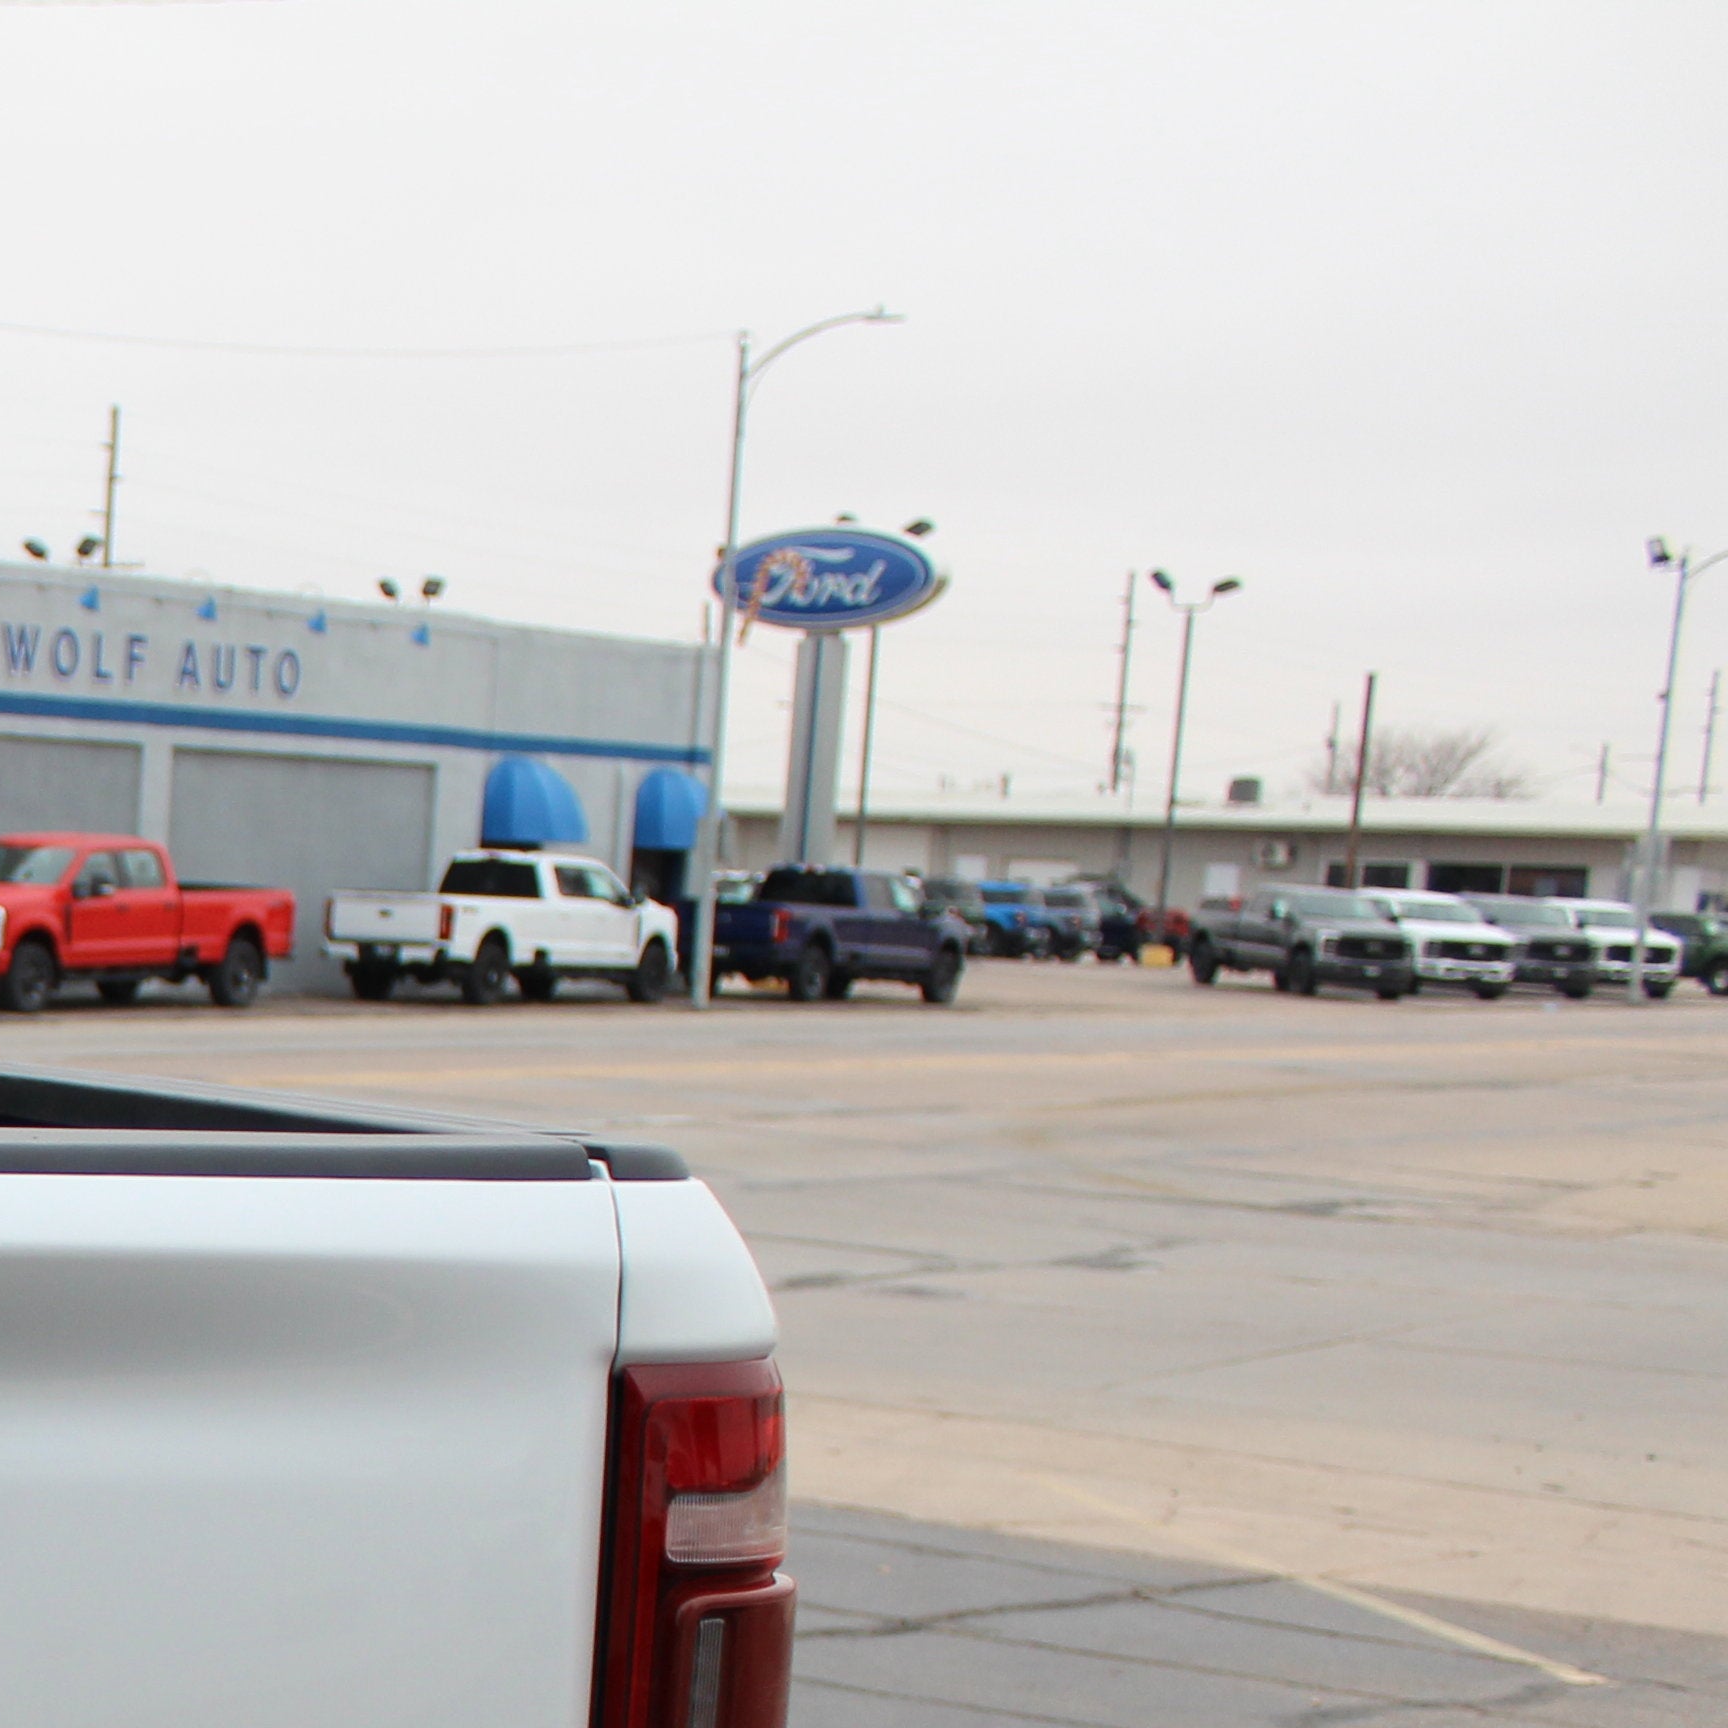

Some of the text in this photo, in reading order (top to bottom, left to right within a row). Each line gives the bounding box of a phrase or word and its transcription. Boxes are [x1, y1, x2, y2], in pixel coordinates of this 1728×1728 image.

[742, 546, 888, 607] Ford
[2, 621, 302, 697] WOLF AUTO
